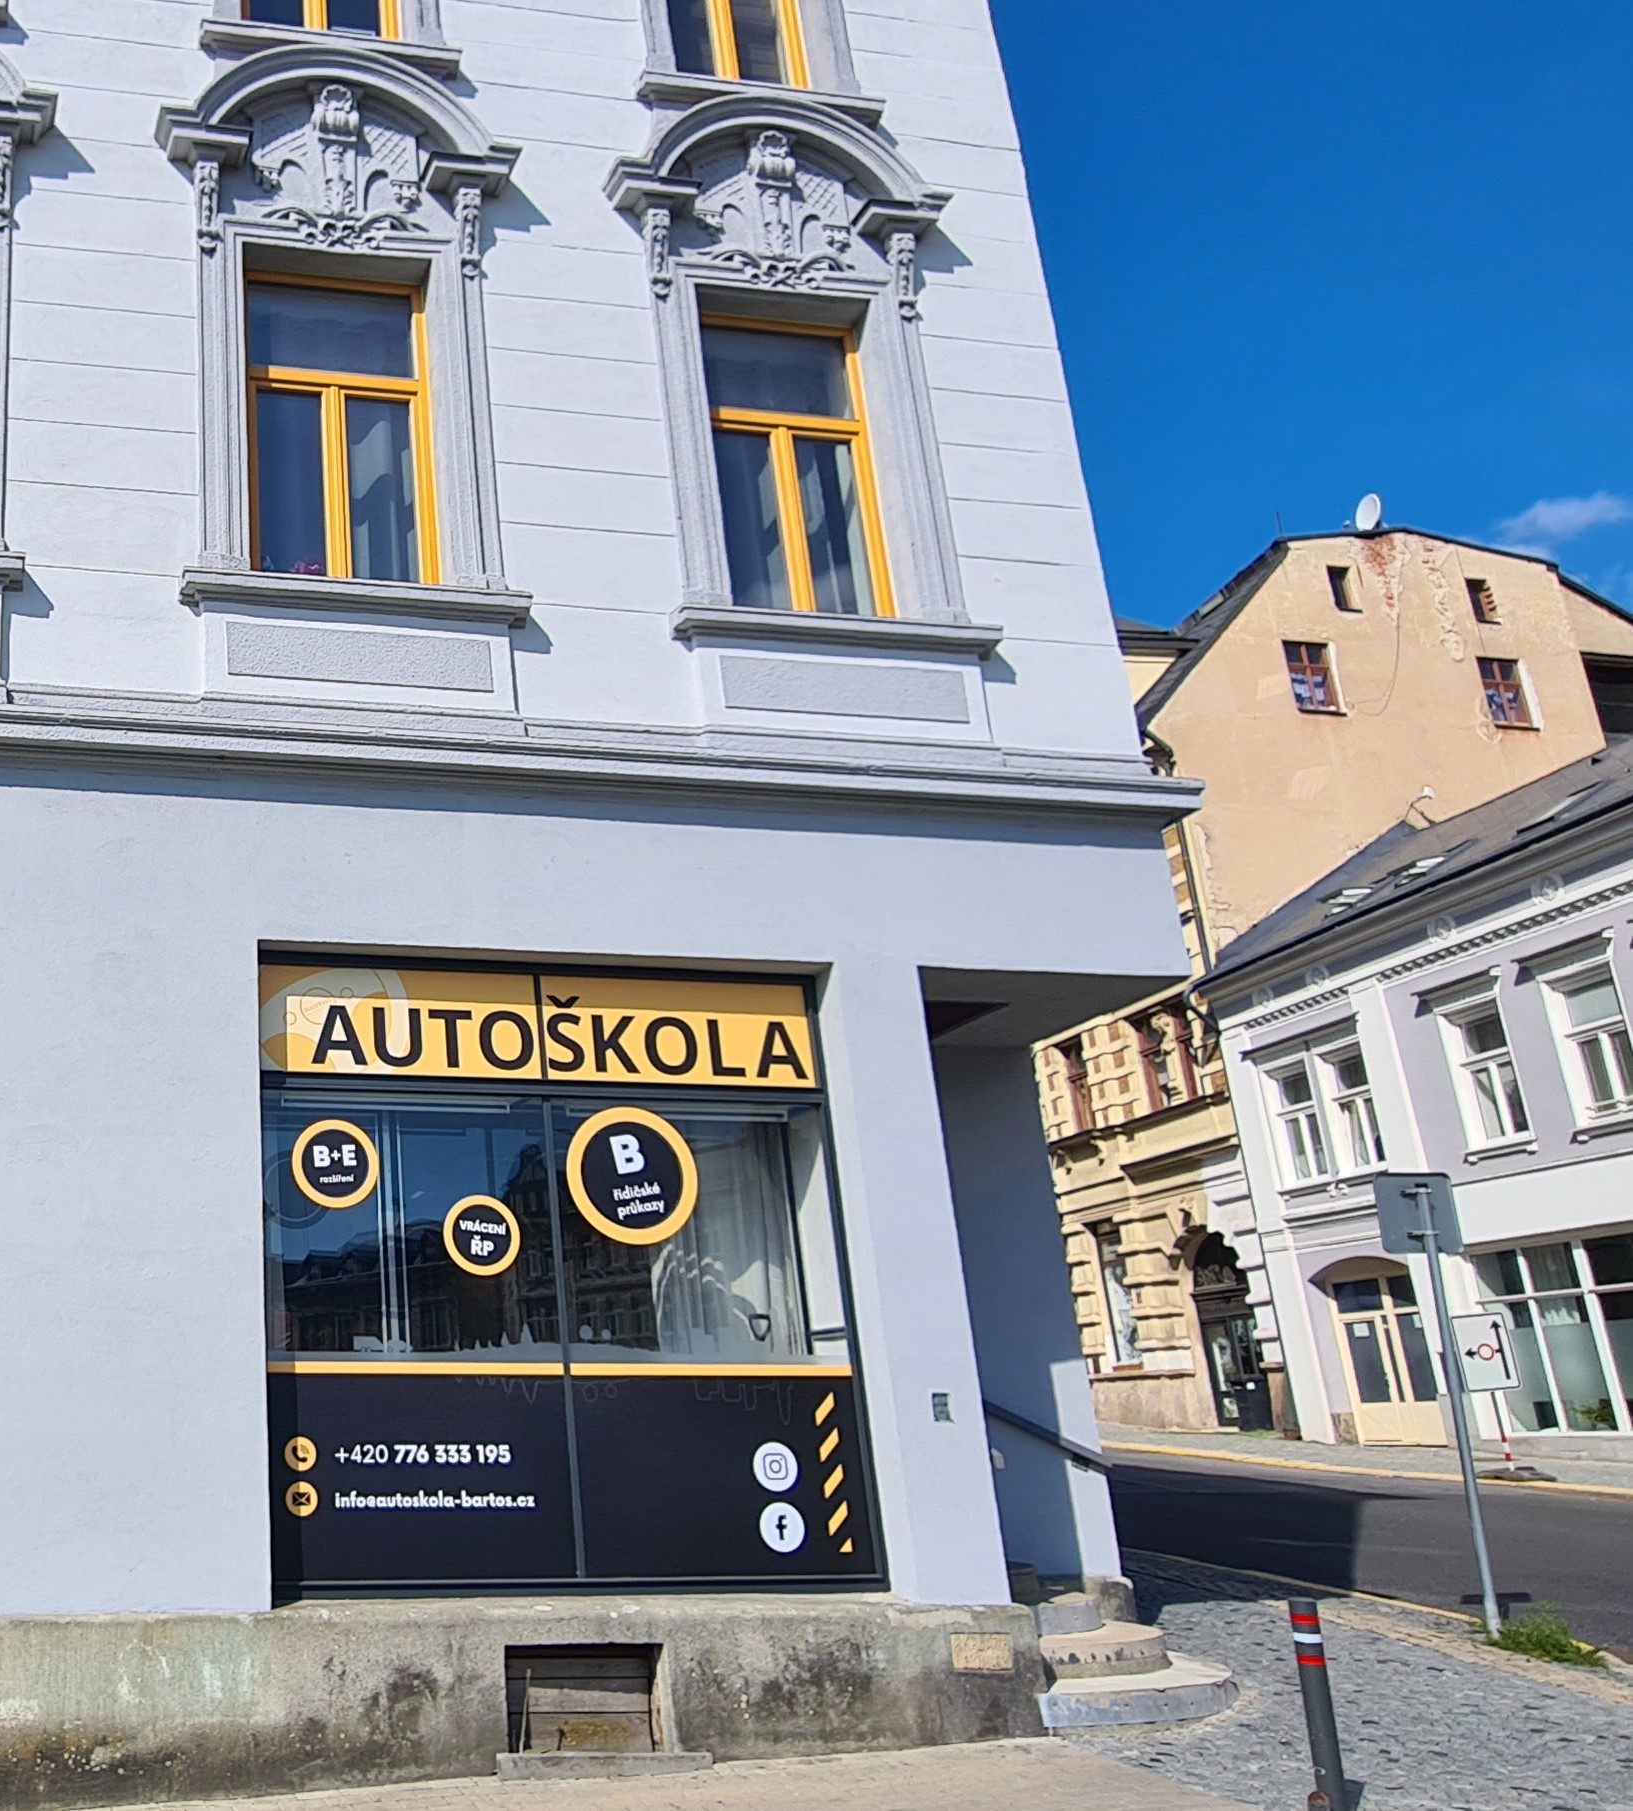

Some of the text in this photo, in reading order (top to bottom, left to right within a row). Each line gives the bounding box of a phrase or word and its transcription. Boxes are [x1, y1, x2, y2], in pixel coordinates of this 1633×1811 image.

[311, 994, 809, 1081] AUTOŠKOLA
[312, 1143, 358, 1168] B+E
[609, 1133, 646, 1175] B
[612, 1181, 662, 1201] řidičské
[617, 1199, 665, 1221] průkazy
[459, 1219, 506, 1236] VRÁCENÍ
[470, 1234, 495, 1257] ŘP
[334, 1444, 512, 1464] +420 776 333 195
[334, 1489, 537, 1509] info@autoskola-bartos.cz
